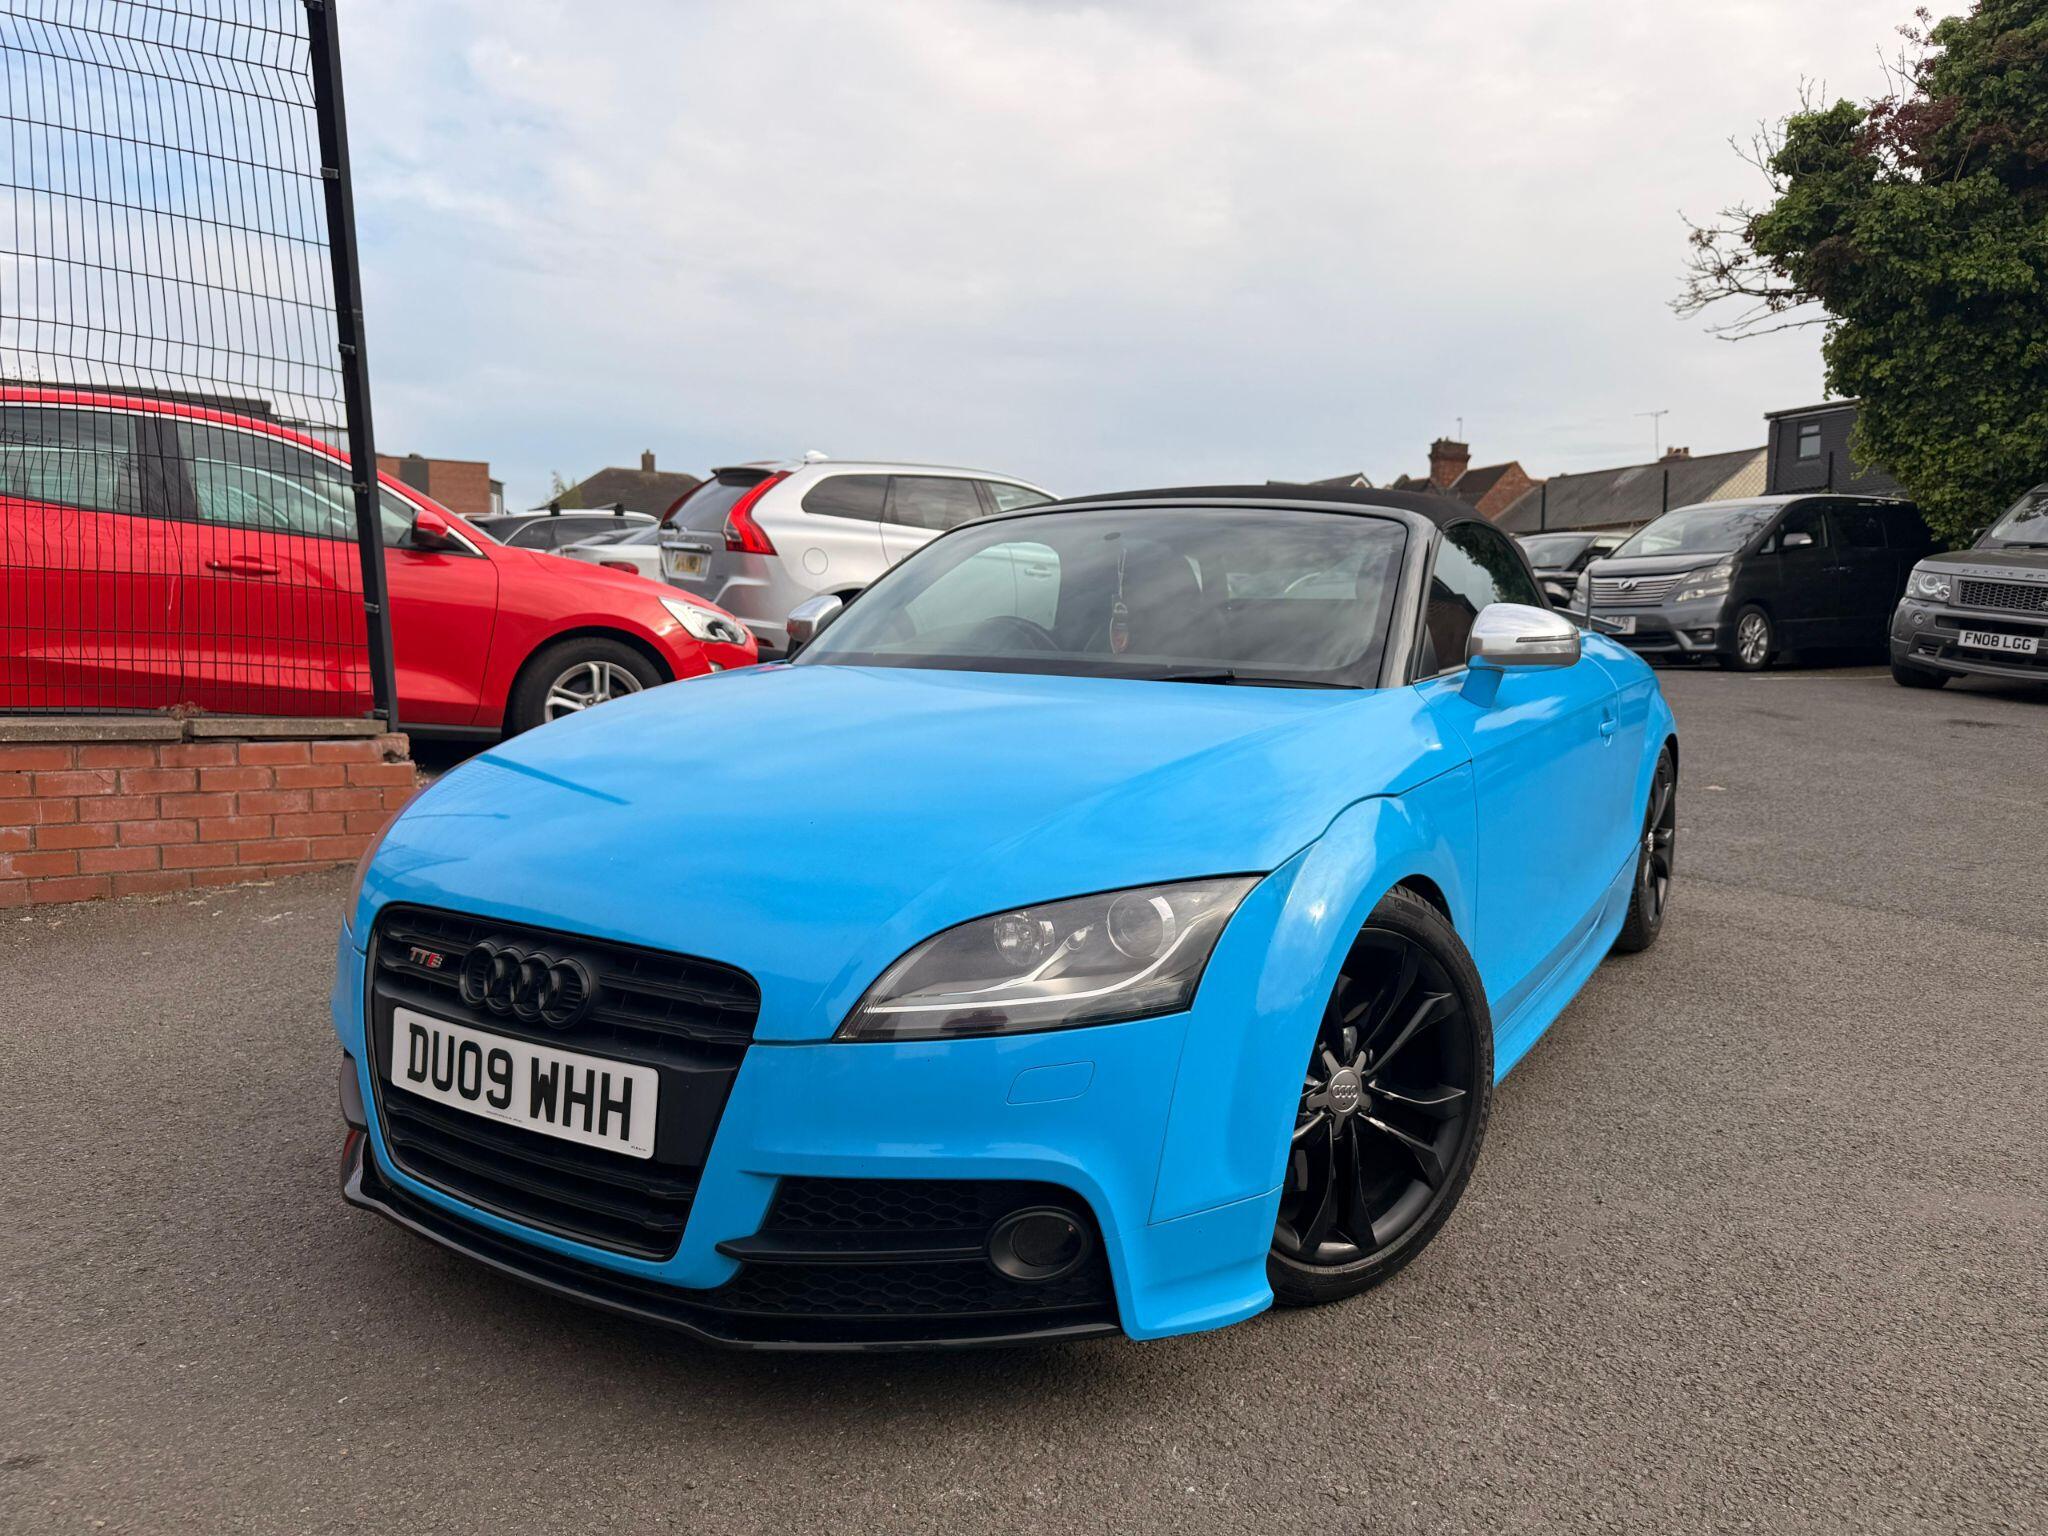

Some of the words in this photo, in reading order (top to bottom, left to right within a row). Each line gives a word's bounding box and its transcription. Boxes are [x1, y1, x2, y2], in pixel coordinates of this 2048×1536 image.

[1964, 632, 2000, 647] FN08
[2003, 636, 2032, 650] LGG
[407, 1022, 513, 1110] DU09
[530, 1056, 633, 1142] WHH
